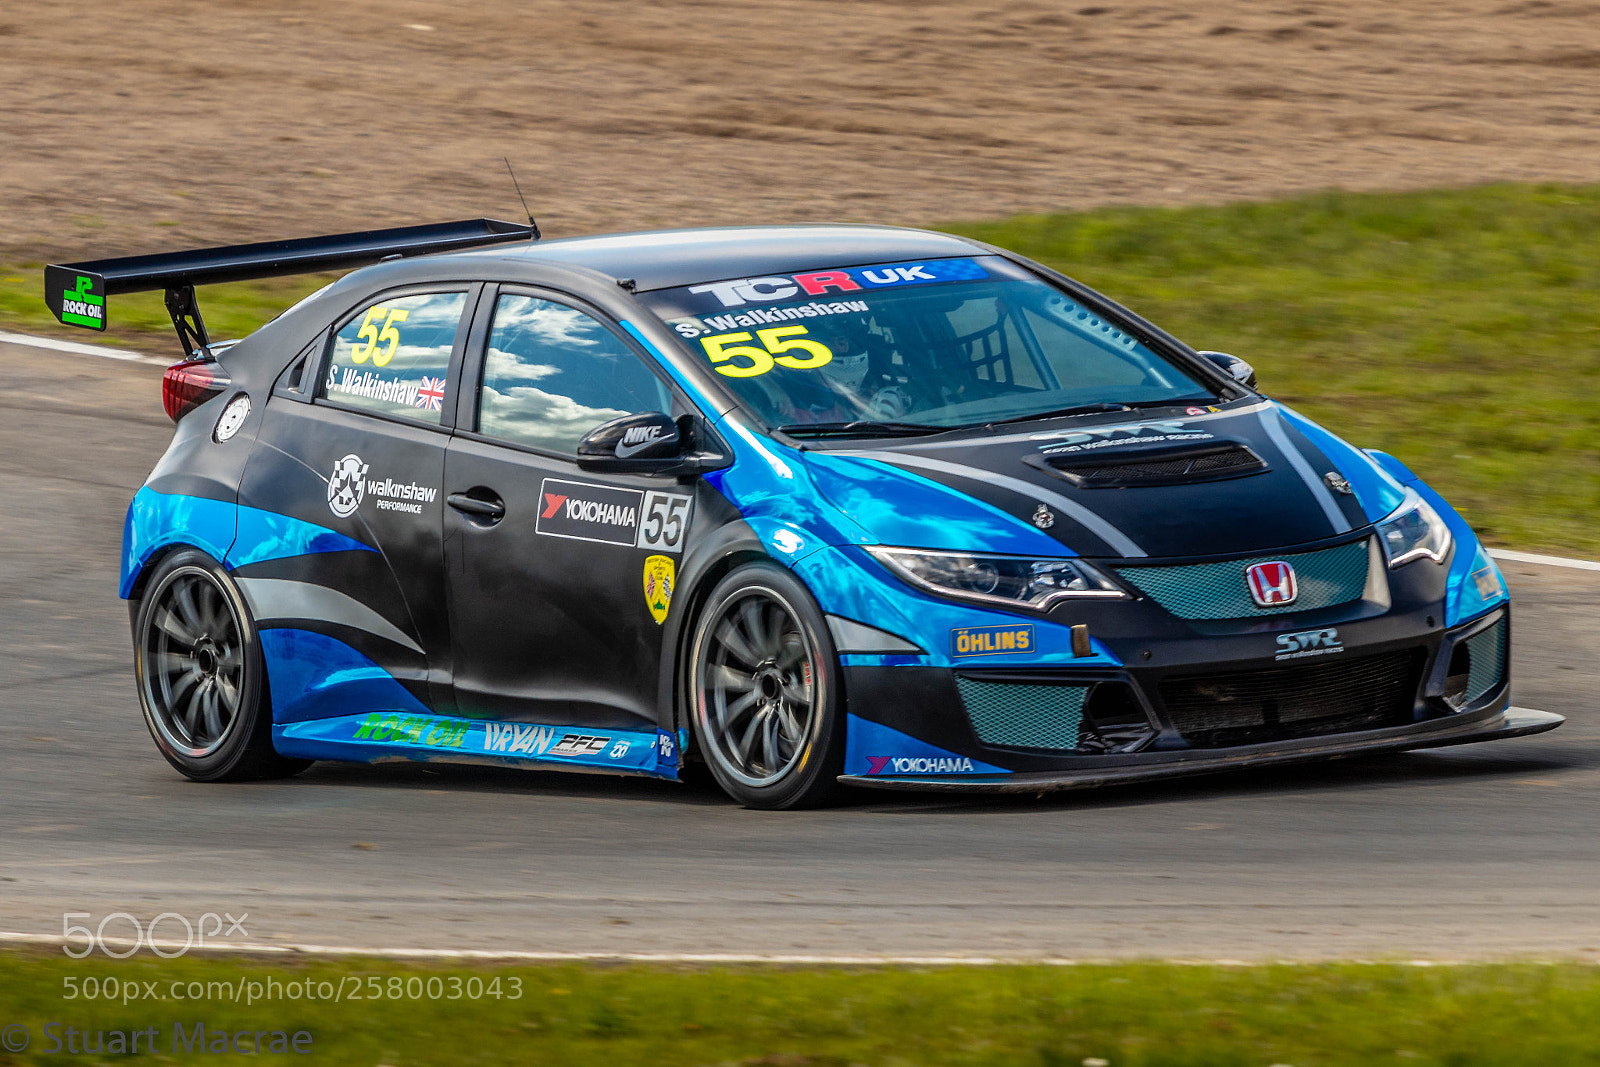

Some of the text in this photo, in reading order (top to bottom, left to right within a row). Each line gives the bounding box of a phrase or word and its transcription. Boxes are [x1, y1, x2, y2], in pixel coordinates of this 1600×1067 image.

[862, 265, 936, 284] UK
[63, 299, 102, 318] ROCK OIL
[351, 306, 409, 367] 55
[700, 325, 833, 378] 55
[326, 364, 420, 406] S. Walkinshaw
[623, 425, 662, 443] NIKE
[367, 478, 437, 502] walkinshaw
[376, 499, 422, 514] PERFORMANCE
[565, 498, 636, 528] YOKOHAMA
[644, 495, 688, 547] 55
[957, 630, 1029, 652] ÖHLINS
[352, 713, 470, 748] ROCK OIL
[891, 757, 974, 773] YOKOHAMA
